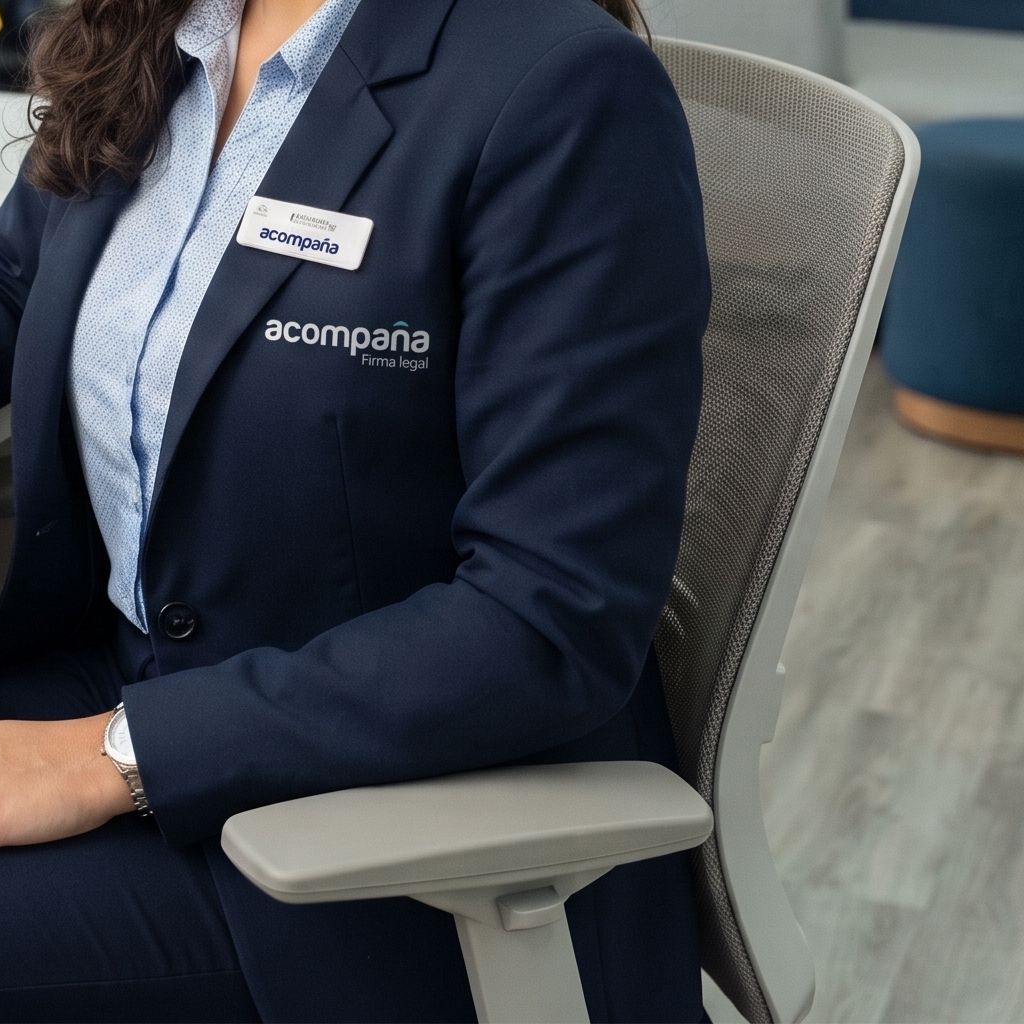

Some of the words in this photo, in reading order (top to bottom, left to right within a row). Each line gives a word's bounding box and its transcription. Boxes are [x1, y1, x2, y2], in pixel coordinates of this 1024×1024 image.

[259, 227, 339, 255] acompaña
[264, 319, 430, 357] acompaña
[361, 354, 396, 368] Firma
[399, 355, 429, 372] legal
